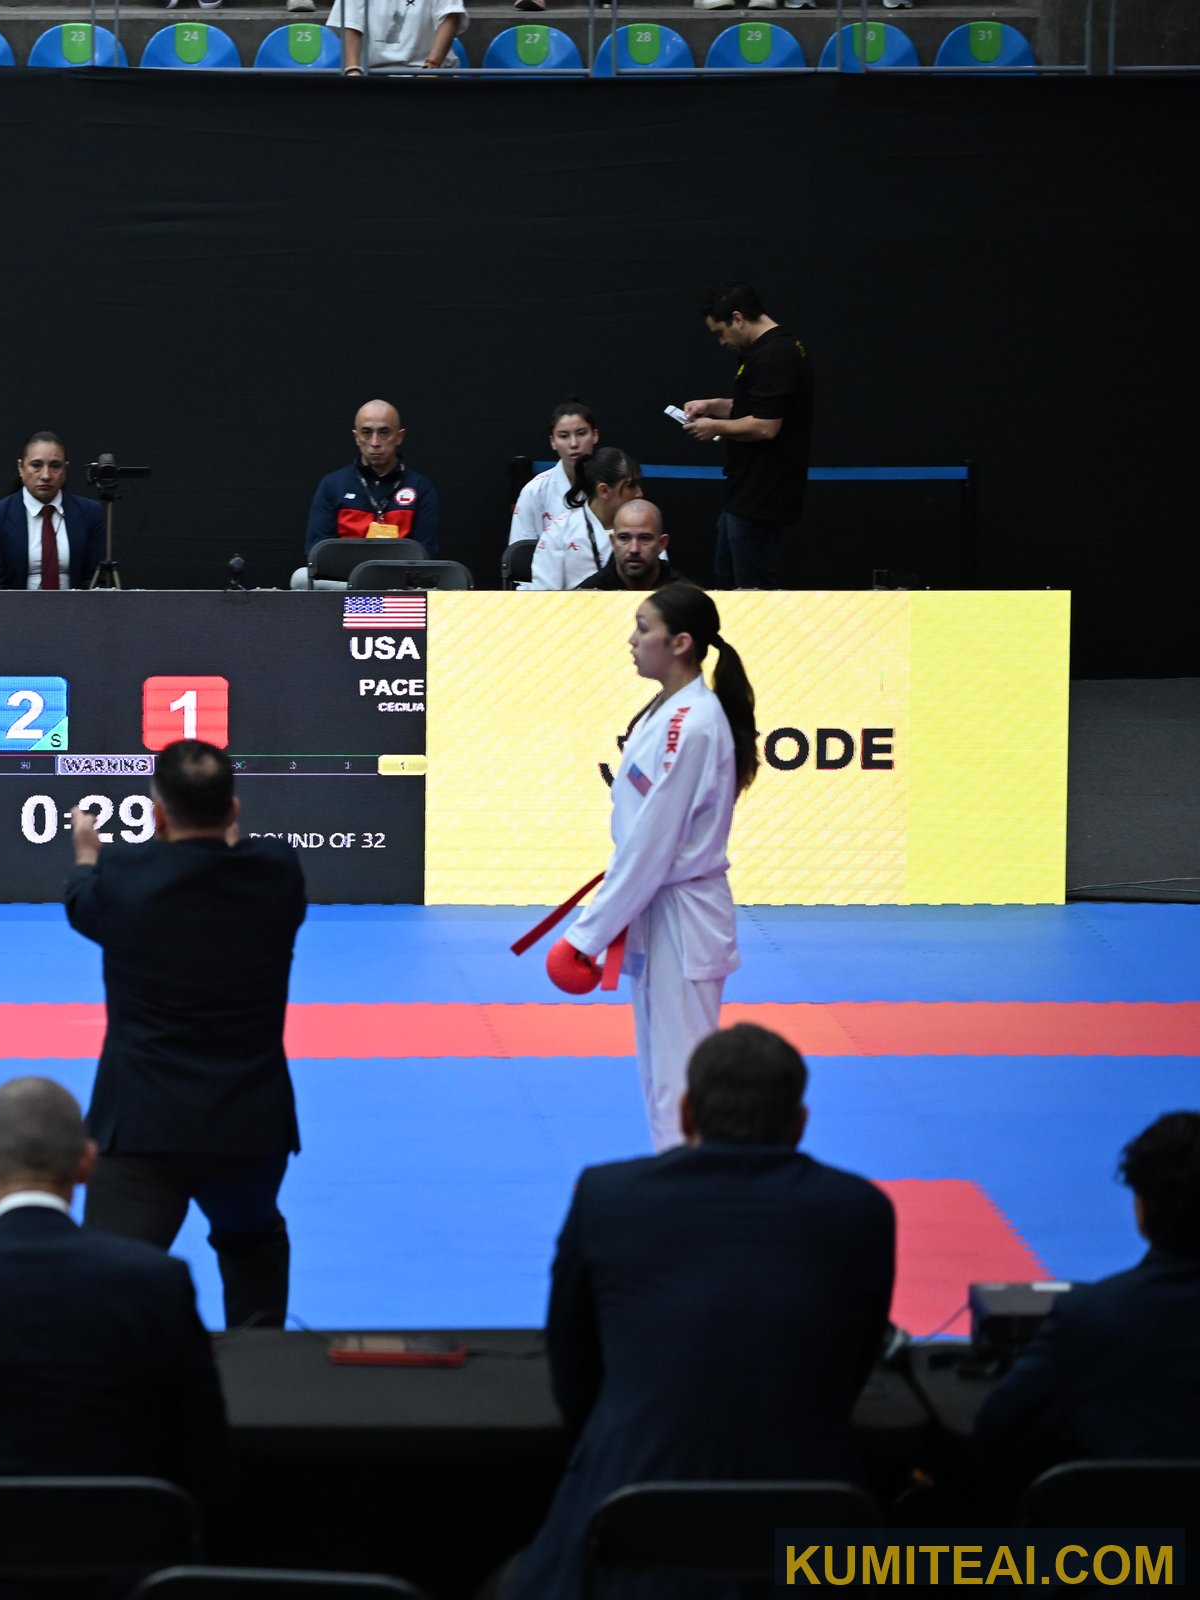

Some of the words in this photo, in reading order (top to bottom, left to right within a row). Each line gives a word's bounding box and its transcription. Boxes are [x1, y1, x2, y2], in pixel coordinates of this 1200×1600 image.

[70, 32, 85, 41] 23
[184, 31, 199, 41] 24
[296, 31, 312, 41] 25
[526, 33, 540, 43] 27
[636, 32, 651, 41] 28
[747, 31, 762, 40] 29
[979, 30, 992, 40] 31
[350, 636, 420, 660] USA
[359, 679, 425, 696] PACE
[5, 690, 44, 740] 2
[169, 690, 197, 740] 1
[50, 734, 62, 748] S
[757, 727, 894, 771] ODE
[63, 758, 149, 772] WARNING
[21, 795, 156, 844] 0:29
[329, 832, 356, 848] OF
[361, 832, 386, 848] 32
